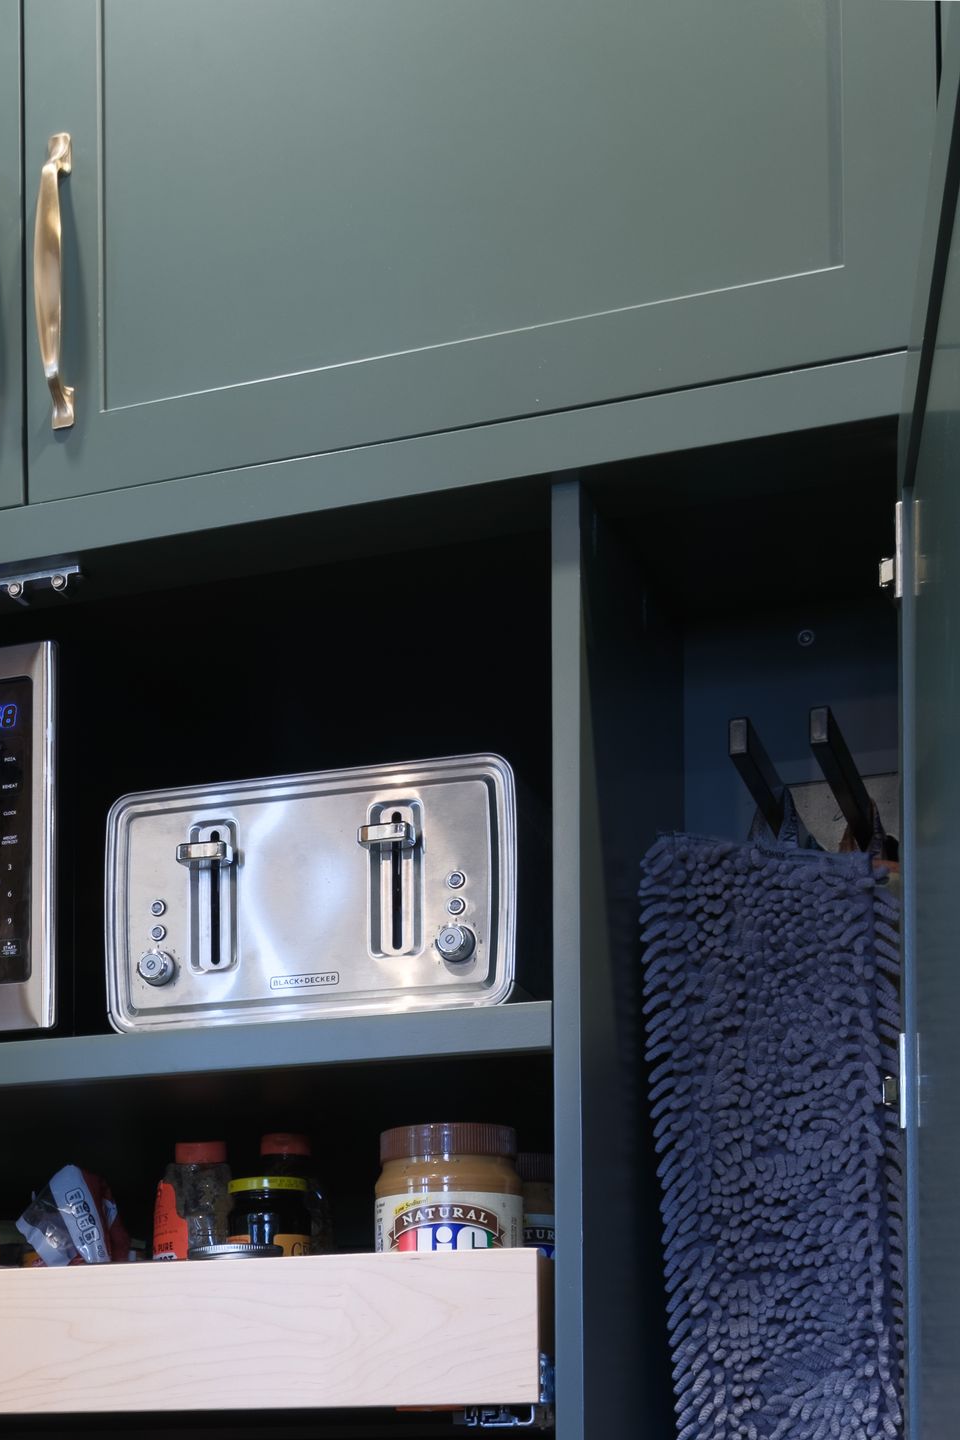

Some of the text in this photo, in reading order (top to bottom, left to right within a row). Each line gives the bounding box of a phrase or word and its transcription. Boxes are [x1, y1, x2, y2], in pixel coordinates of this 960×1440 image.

[8, 863, 12, 871] 3
[7, 890, 12, 898] 6
[273, 975, 336, 987] BLACK+DECKER
[402, 1206, 489, 1226] NATURAL
